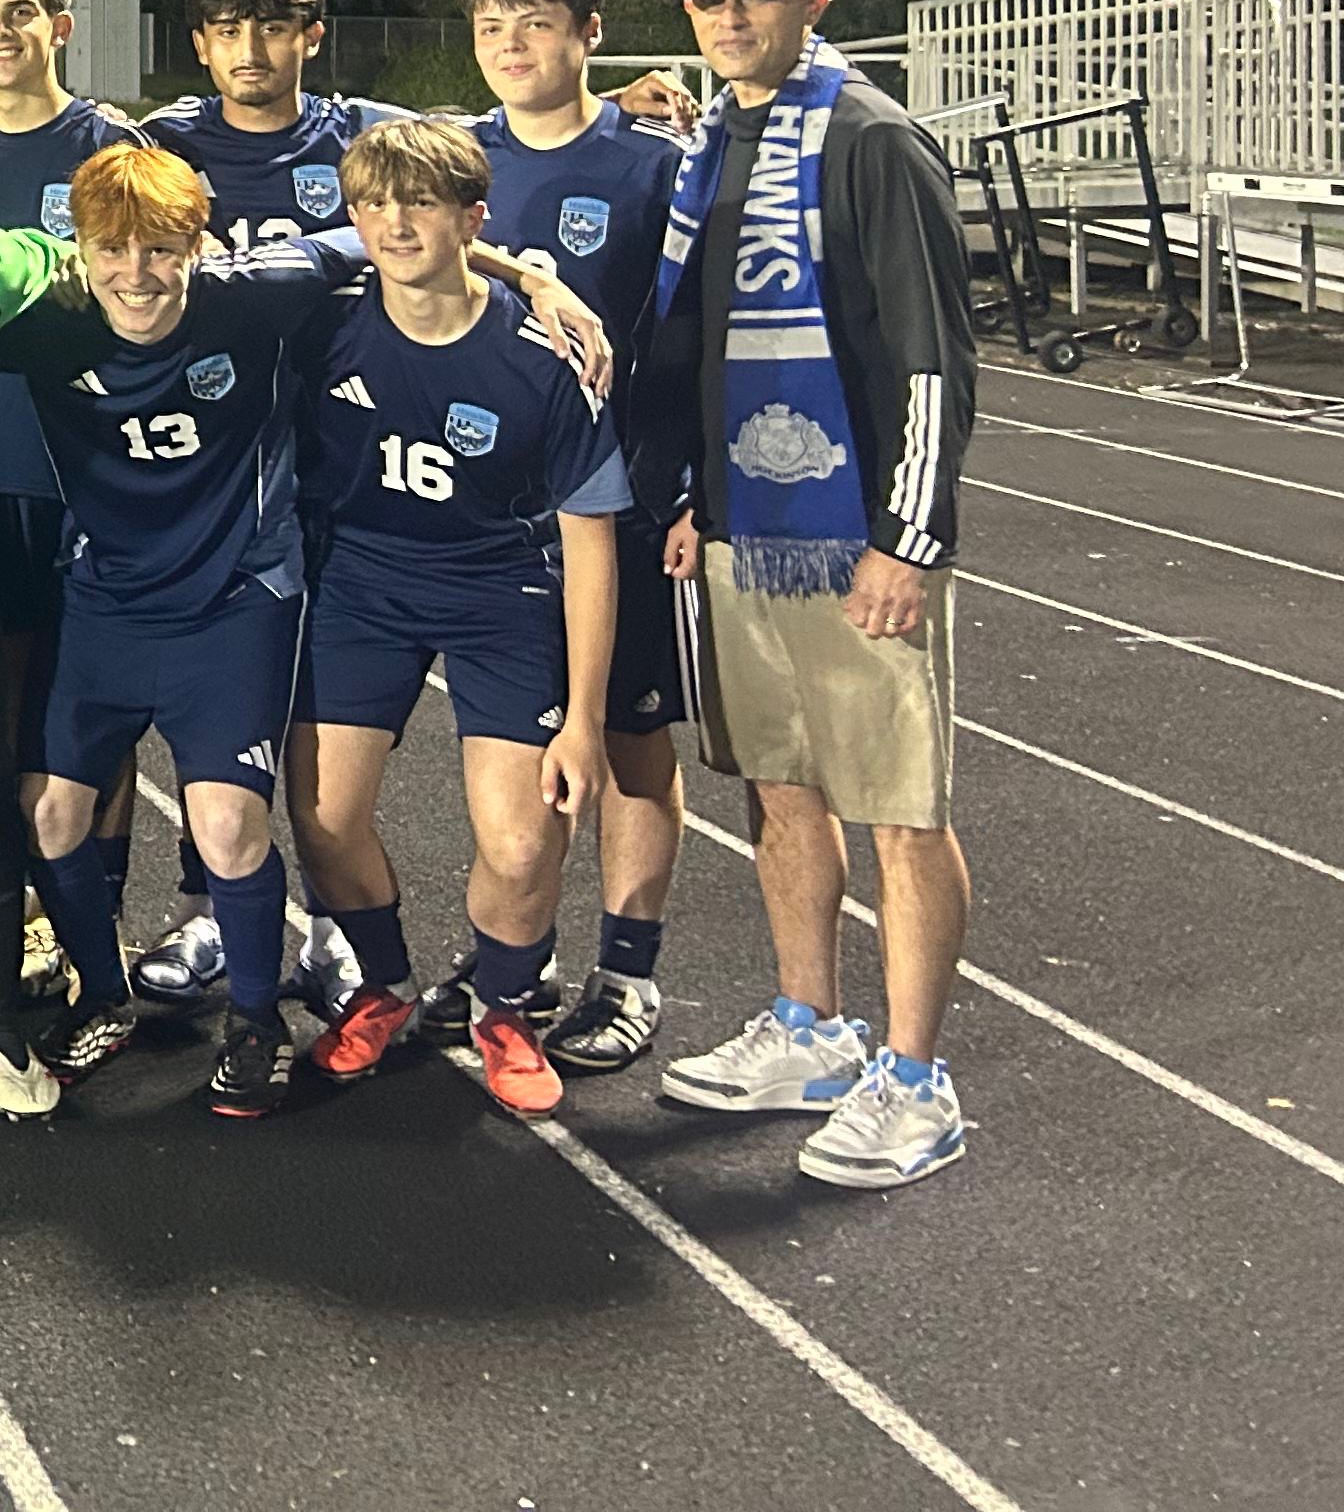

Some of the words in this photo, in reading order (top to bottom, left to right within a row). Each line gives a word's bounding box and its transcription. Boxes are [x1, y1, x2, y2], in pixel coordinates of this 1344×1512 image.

[735, 105, 803, 293] HAWKS
[121, 413, 201, 460] 13
[379, 435, 454, 502] 16
